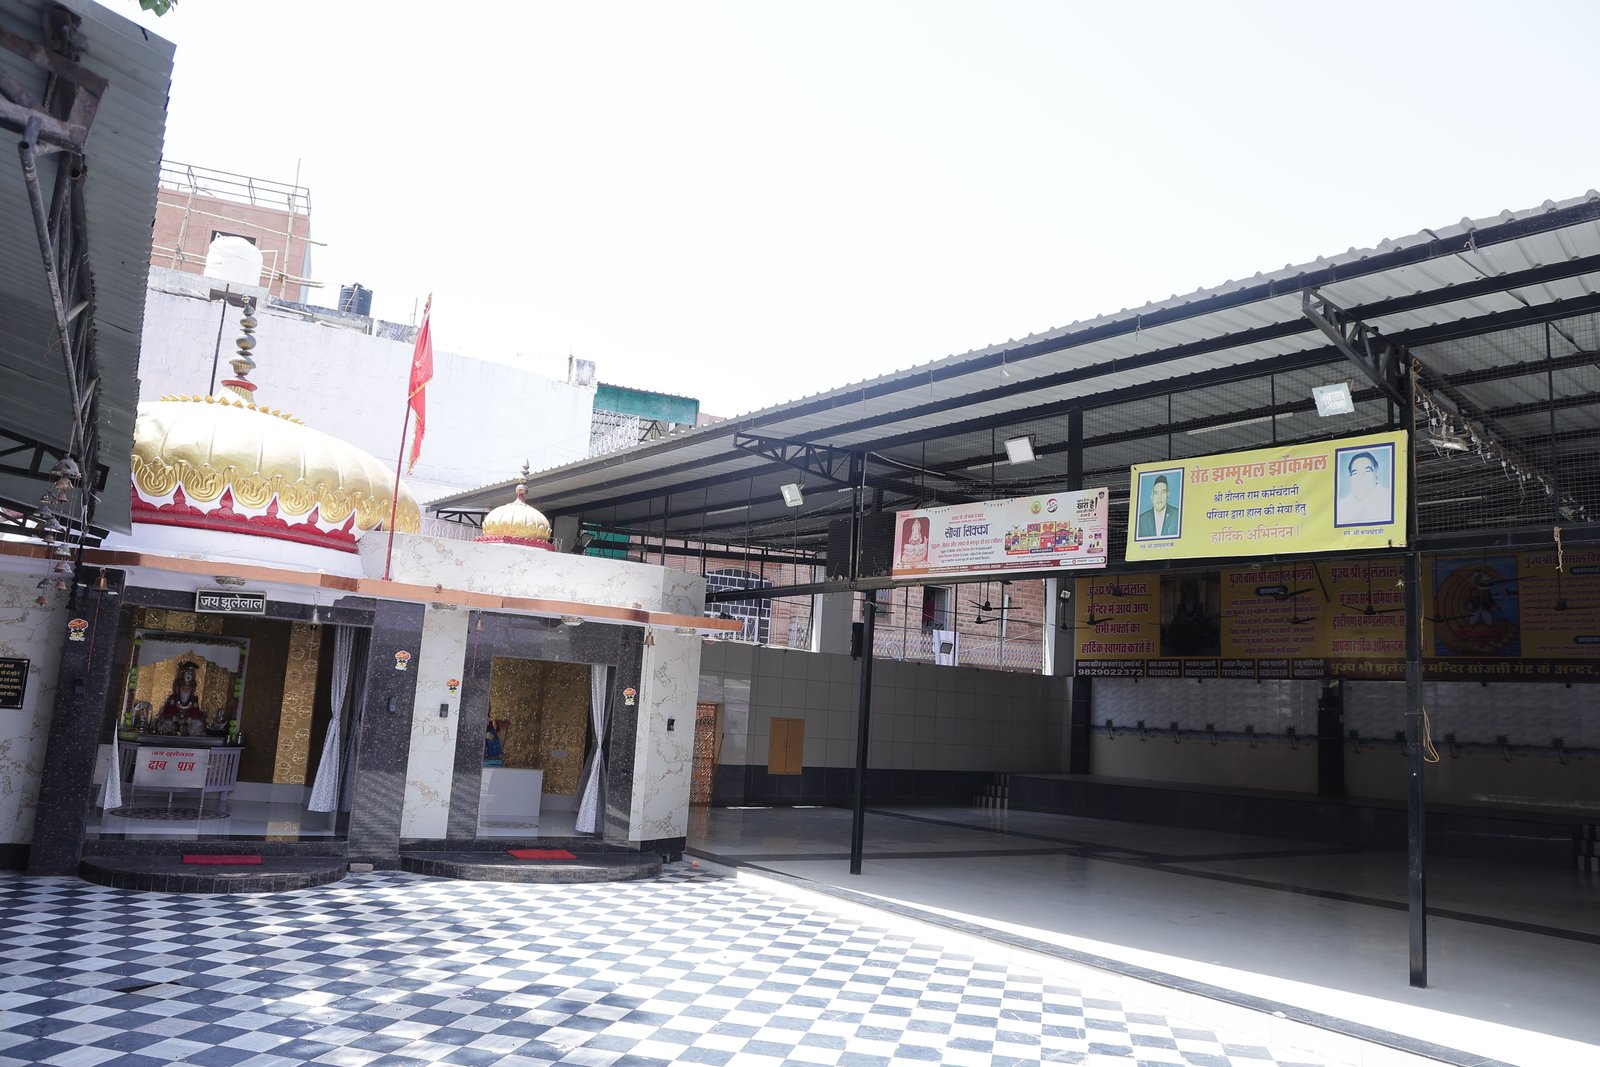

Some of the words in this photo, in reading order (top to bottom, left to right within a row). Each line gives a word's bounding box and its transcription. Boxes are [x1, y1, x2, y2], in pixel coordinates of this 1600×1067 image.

[1190, 466, 1210, 484] सेठ
[1213, 491, 1223, 502] श्री
[1247, 490, 1259, 500] राम
[1206, 508, 1229, 520] परिवार
[1231, 509, 1245, 520] द्वारा
[1246, 507, 1262, 518] हाल
[1263, 503, 1275, 515] की
[1276, 502, 1293, 514] सेवा
[1294, 501, 1307, 515] हेतु
[962, 522, 992, 539] सिक्का
[1211, 526, 1244, 543] हार्दिक
[1350, 564, 1361, 578] श्री
[201, 596, 219, 609] जय
[1133, 603, 1149, 613] आप
[1095, 621, 1109, 634] सभी
[1129, 624, 1141, 633] का
[1081, 640, 1104, 653] हार्दिक
[1104, 643, 1127, 653] स्वागत
[1078, 668, 1143, 676] 9829022372
[1358, 661, 1374, 672] श्री
[1427, 661, 1464, 673] मन्दिर
[1536, 661, 1551, 674] के
[147, 760, 169, 771] दान
[177, 761, 196, 772] पात्र
